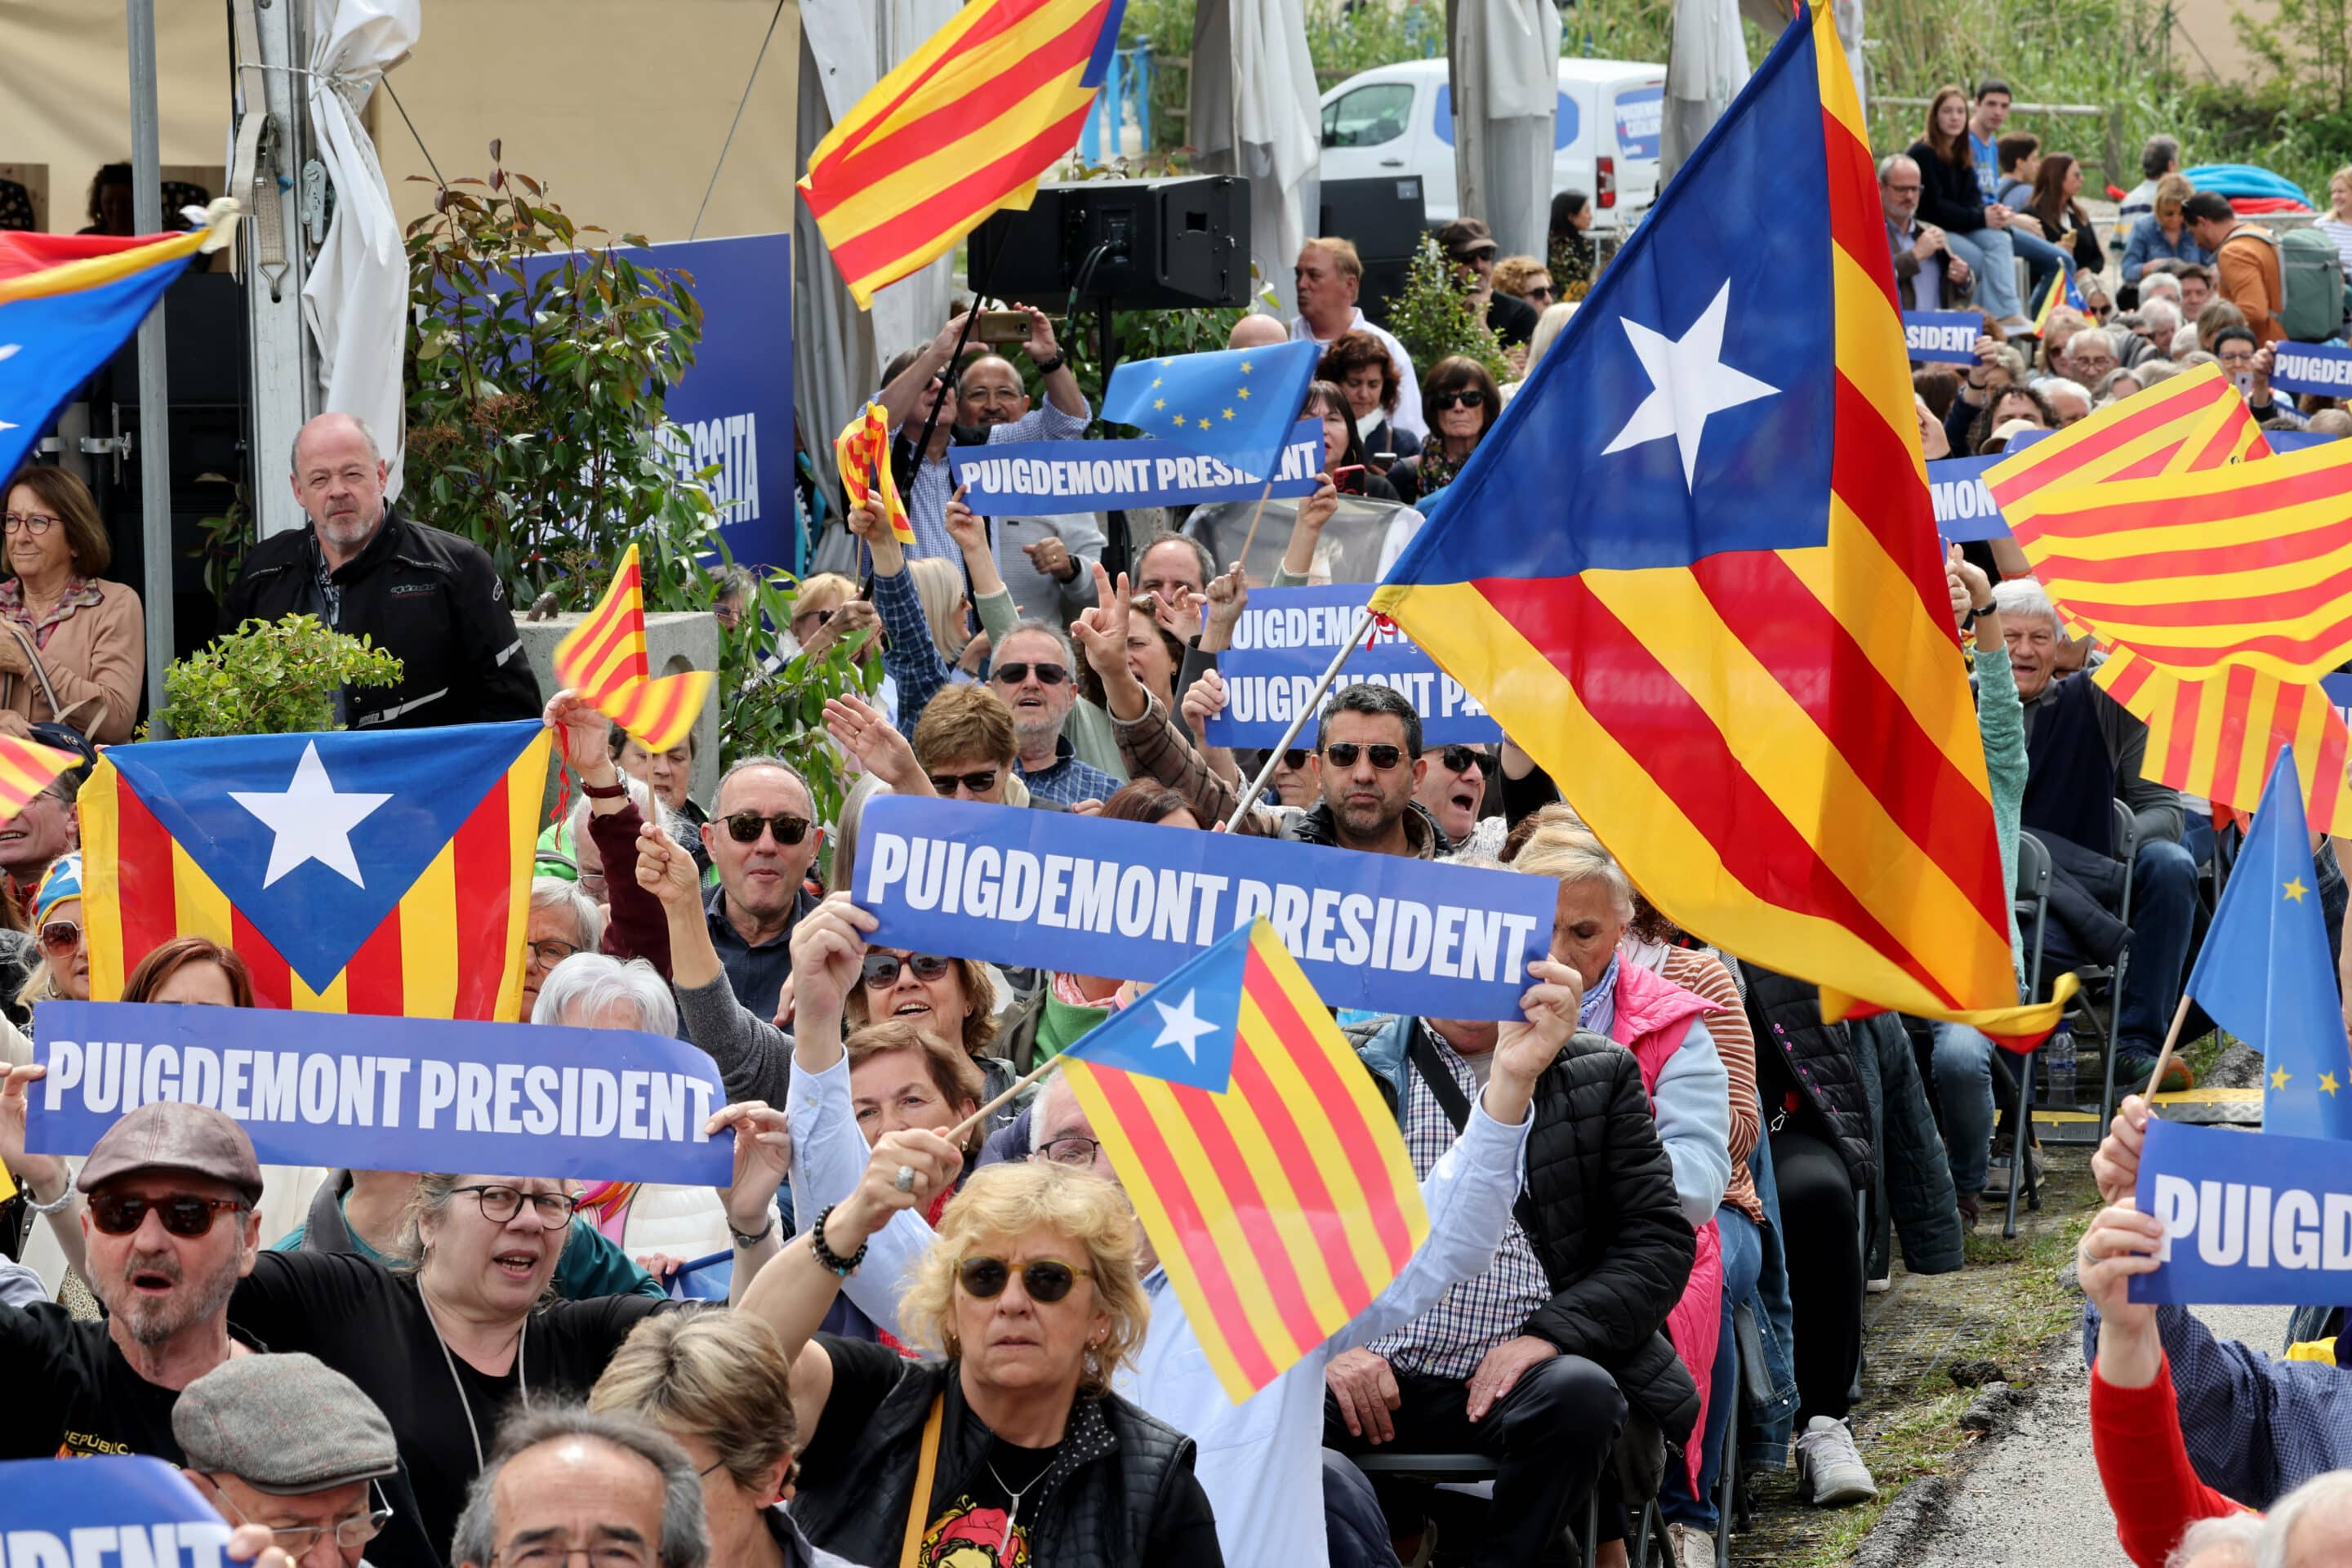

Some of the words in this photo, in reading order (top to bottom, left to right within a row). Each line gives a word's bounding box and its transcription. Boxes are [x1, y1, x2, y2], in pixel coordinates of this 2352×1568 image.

[1906, 325, 1976, 352] SIDENT
[960, 457, 1151, 496] PUIGDEMONT
[866, 831, 1229, 947] PUIGDEMONT
[1234, 878, 1538, 985] PRESIDENT
[43, 1040, 411, 1128] PUIGDEMONT
[418, 1059, 715, 1143] PRESIDENT
